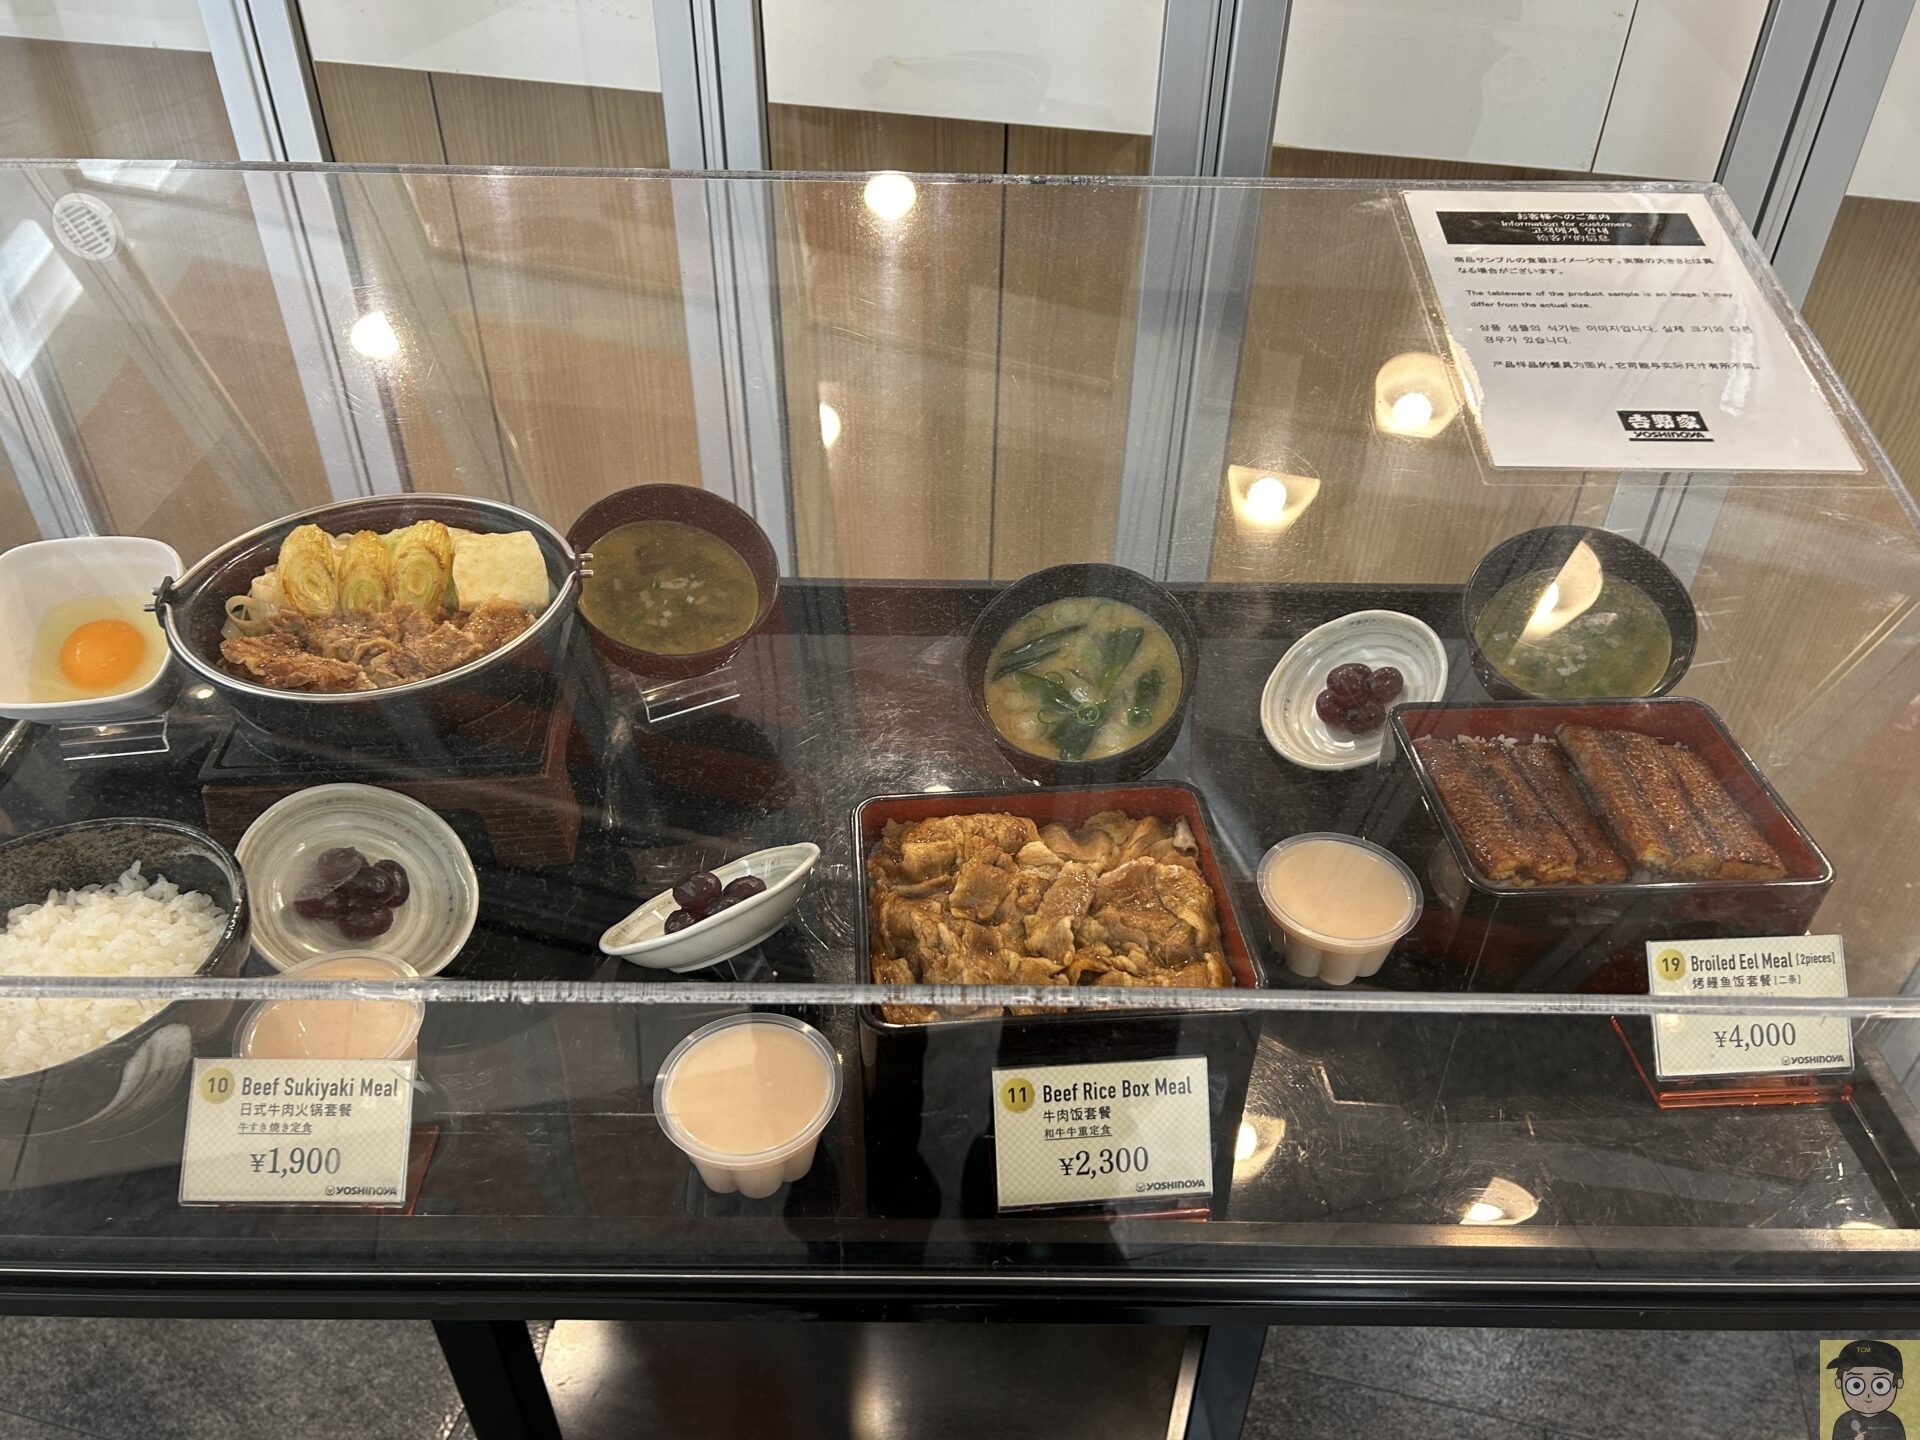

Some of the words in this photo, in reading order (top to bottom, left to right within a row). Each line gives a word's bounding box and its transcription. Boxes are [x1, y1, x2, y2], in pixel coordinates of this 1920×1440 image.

[1500, 220, 1559, 228] Information
[1561, 220, 1575, 228] for
[1465, 289, 1484, 297] The
[1568, 291, 1605, 299] product
[1608, 291, 1640, 299] sample
[1479, 324, 1501, 332] 상품
[1546, 324, 1580, 333] 식기는
[1483, 335, 1517, 344] 경우가
[1522, 336, 1572, 345] 있습니다.
[1662, 957, 1681, 972] 19
[1691, 954, 1736, 972] Broiled
[1739, 953, 1759, 970] Eel
[1761, 951, 1793, 969] Meal
[1713, 1022, 1797, 1051] ¥4,000
[207, 1076, 229, 1094] 10
[241, 1077, 280, 1096] Beef
[284, 1077, 354, 1101] Sukiyaki
[359, 1077, 399, 1097] Meal
[1008, 1086, 1028, 1103] 11
[1042, 1083, 1078, 1103] Beef
[1083, 1081, 1117, 1100] Rice
[1122, 1079, 1150, 1098] Box
[1154, 1076, 1192, 1096] Meal
[240, 1102, 353, 1117] 日式牛肉火锅套餐
[1042, 1105, 1112, 1123] 牛肉饭套餐
[238, 1121, 313, 1134] 牛すき焼き定食
[1044, 1124, 1112, 1139] 和牛牛重定食
[250, 1147, 342, 1178] ¥1,900
[1058, 1146, 1149, 1180] ¥2,300
